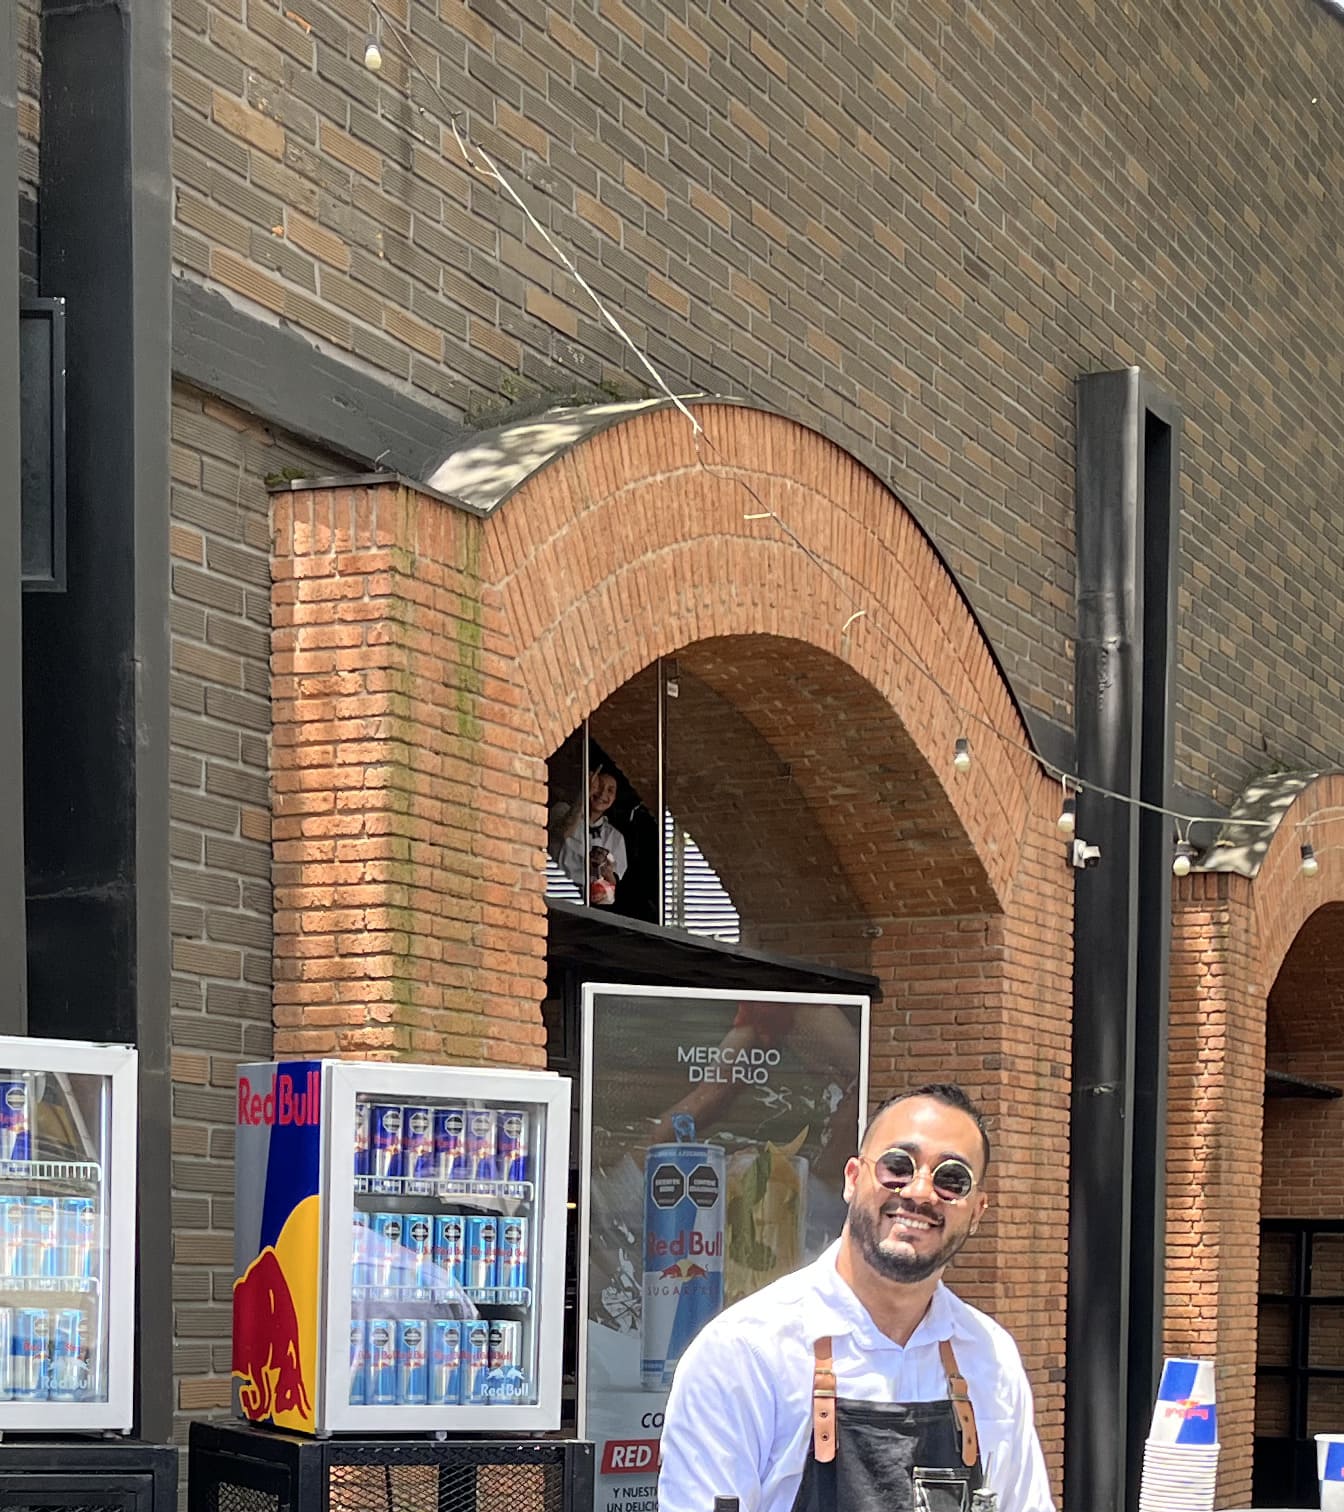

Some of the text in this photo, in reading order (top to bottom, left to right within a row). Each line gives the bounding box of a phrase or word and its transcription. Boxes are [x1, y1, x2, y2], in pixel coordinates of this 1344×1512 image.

[677, 1046, 781, 1065] MERCADO
[688, 1066, 728, 1083] DEL
[238, 1071, 320, 1126] Red Bull
[648, 1230, 723, 1256] Red Bull
[480, 1383, 529, 1397] Red Bull
[641, 1412, 665, 1429] CO
[610, 1445, 652, 1468] RED
[613, 1487, 620, 1498] Y
[607, 1500, 658, 1512] UN DELICI
